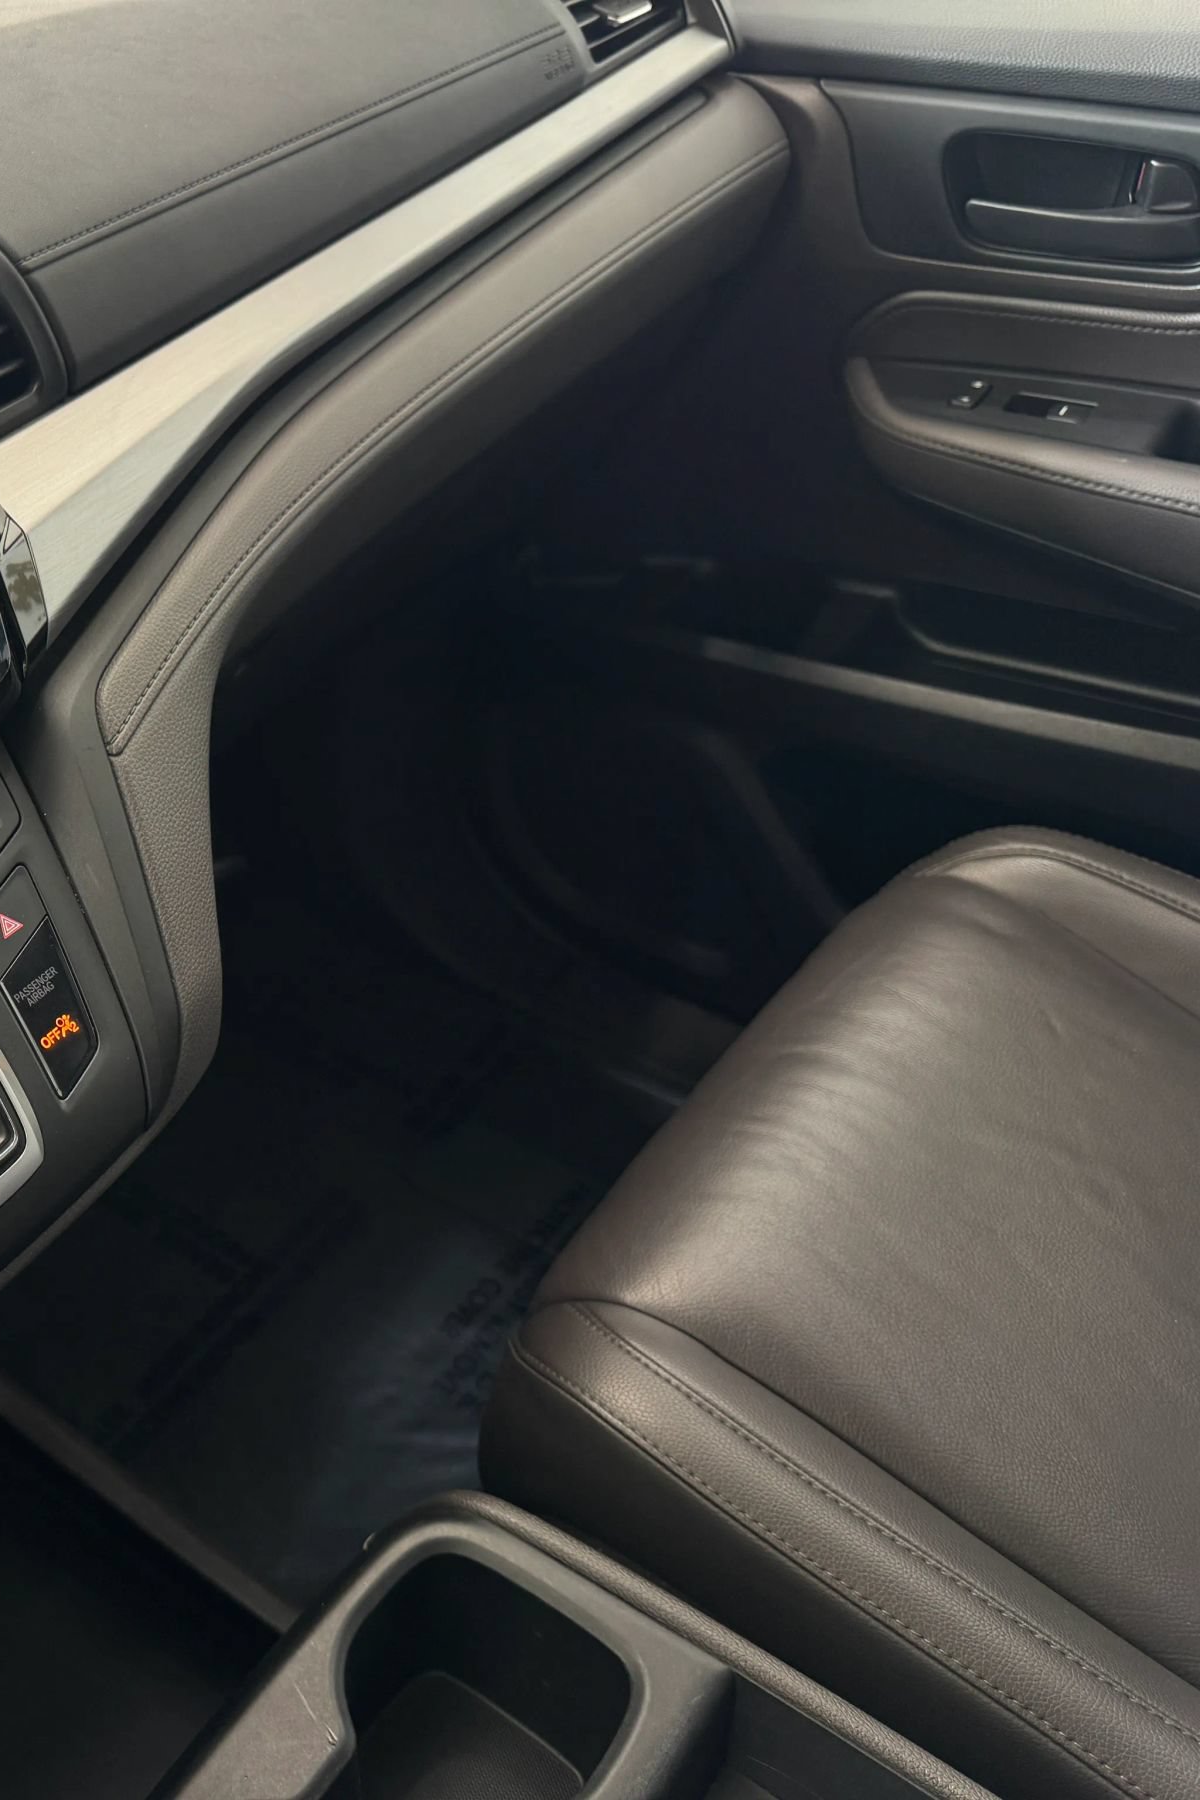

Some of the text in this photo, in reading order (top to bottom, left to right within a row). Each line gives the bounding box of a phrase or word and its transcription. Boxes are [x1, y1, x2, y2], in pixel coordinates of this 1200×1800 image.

[13, 966, 59, 1004] PASSENGER
[26, 981, 55, 1007] AIRBAG
[40, 1026, 61, 1049] OFF
